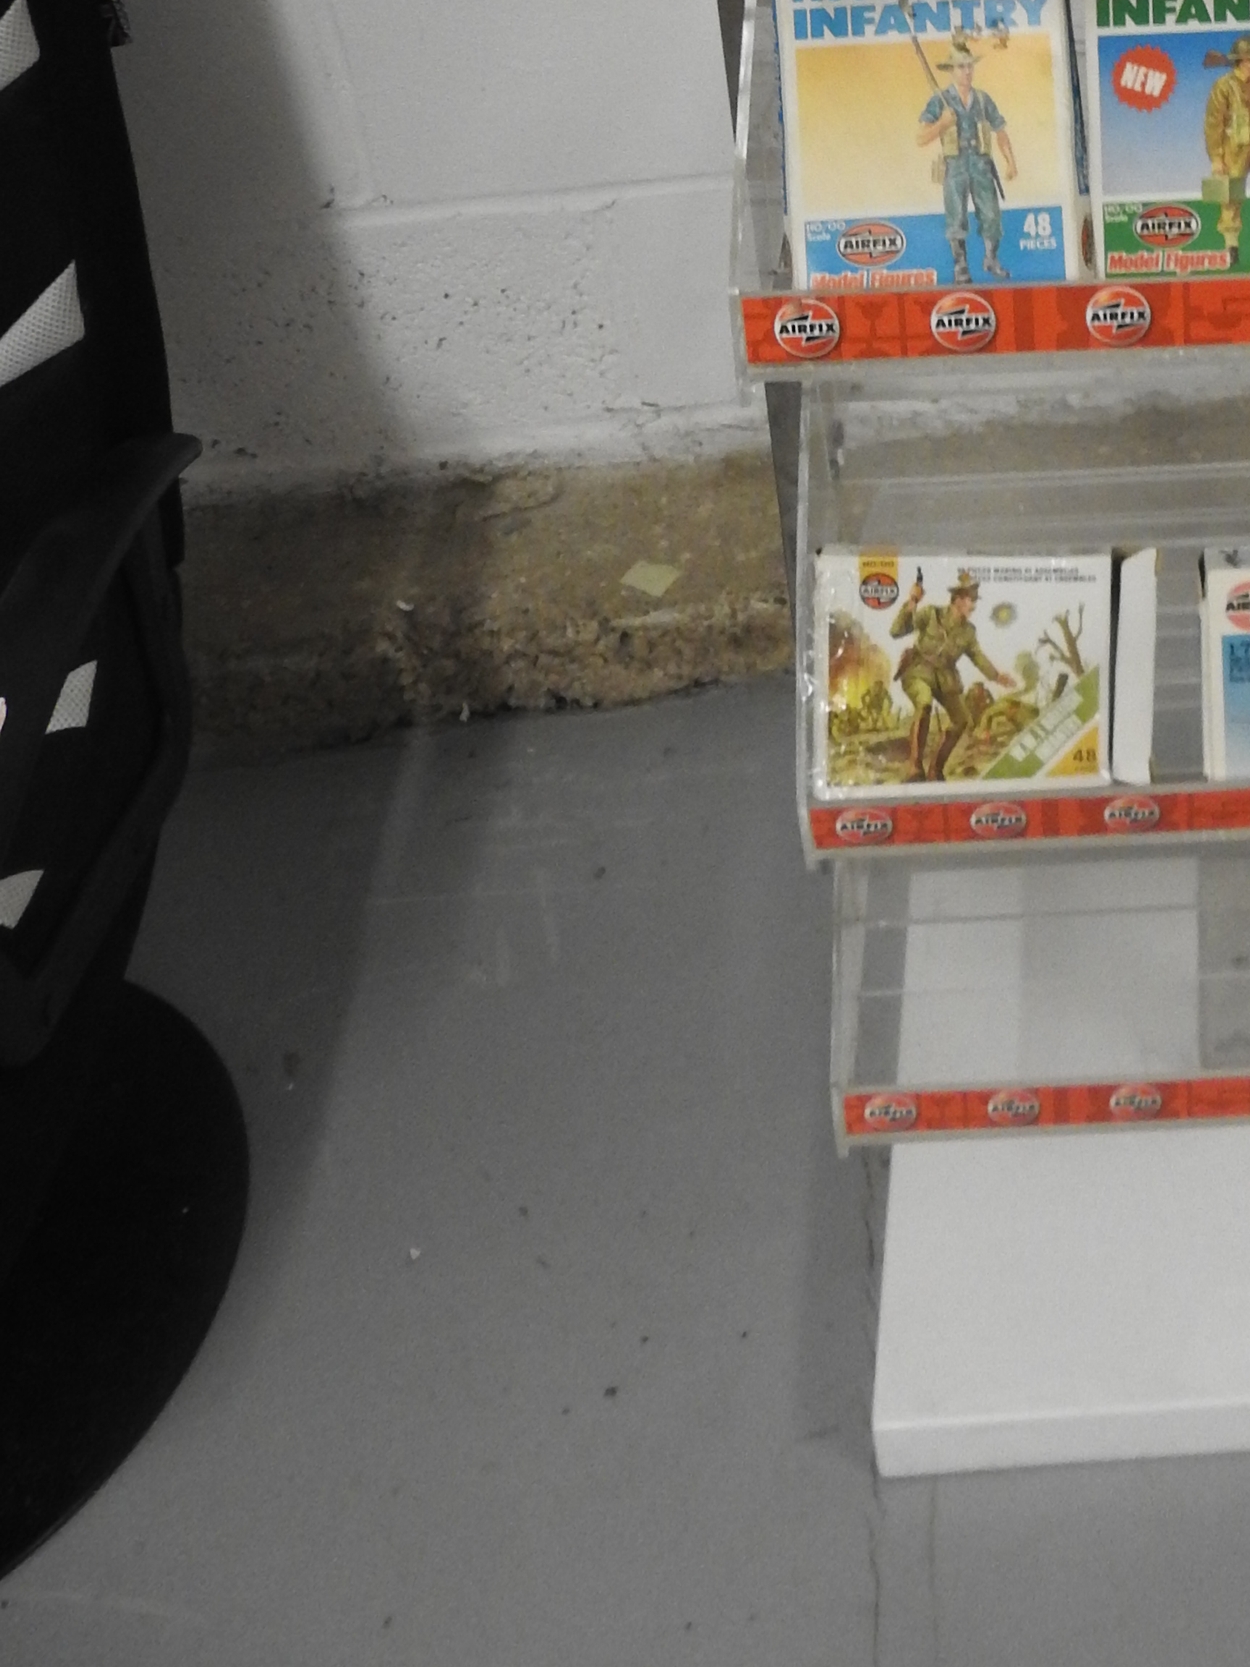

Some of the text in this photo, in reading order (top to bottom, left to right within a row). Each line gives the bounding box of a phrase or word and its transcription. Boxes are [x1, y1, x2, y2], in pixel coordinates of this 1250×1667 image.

[1119, 61, 1168, 98] NEW
[1023, 212, 1052, 238] 48
[1139, 218, 1192, 232] AIRFIX
[843, 236, 898, 251] AIRFIX
[1020, 237, 1058, 251] PIECES
[1108, 250, 1230, 274] Model Figures
[1090, 310, 1147, 323] AIRFIX
[778, 322, 837, 335] AIRFIX
[935, 318, 993, 331] AIRFIX
[1073, 748, 1097, 763] 48
[840, 821, 890, 833] AIRFIX
[974, 815, 1023, 827] AIRFIX
